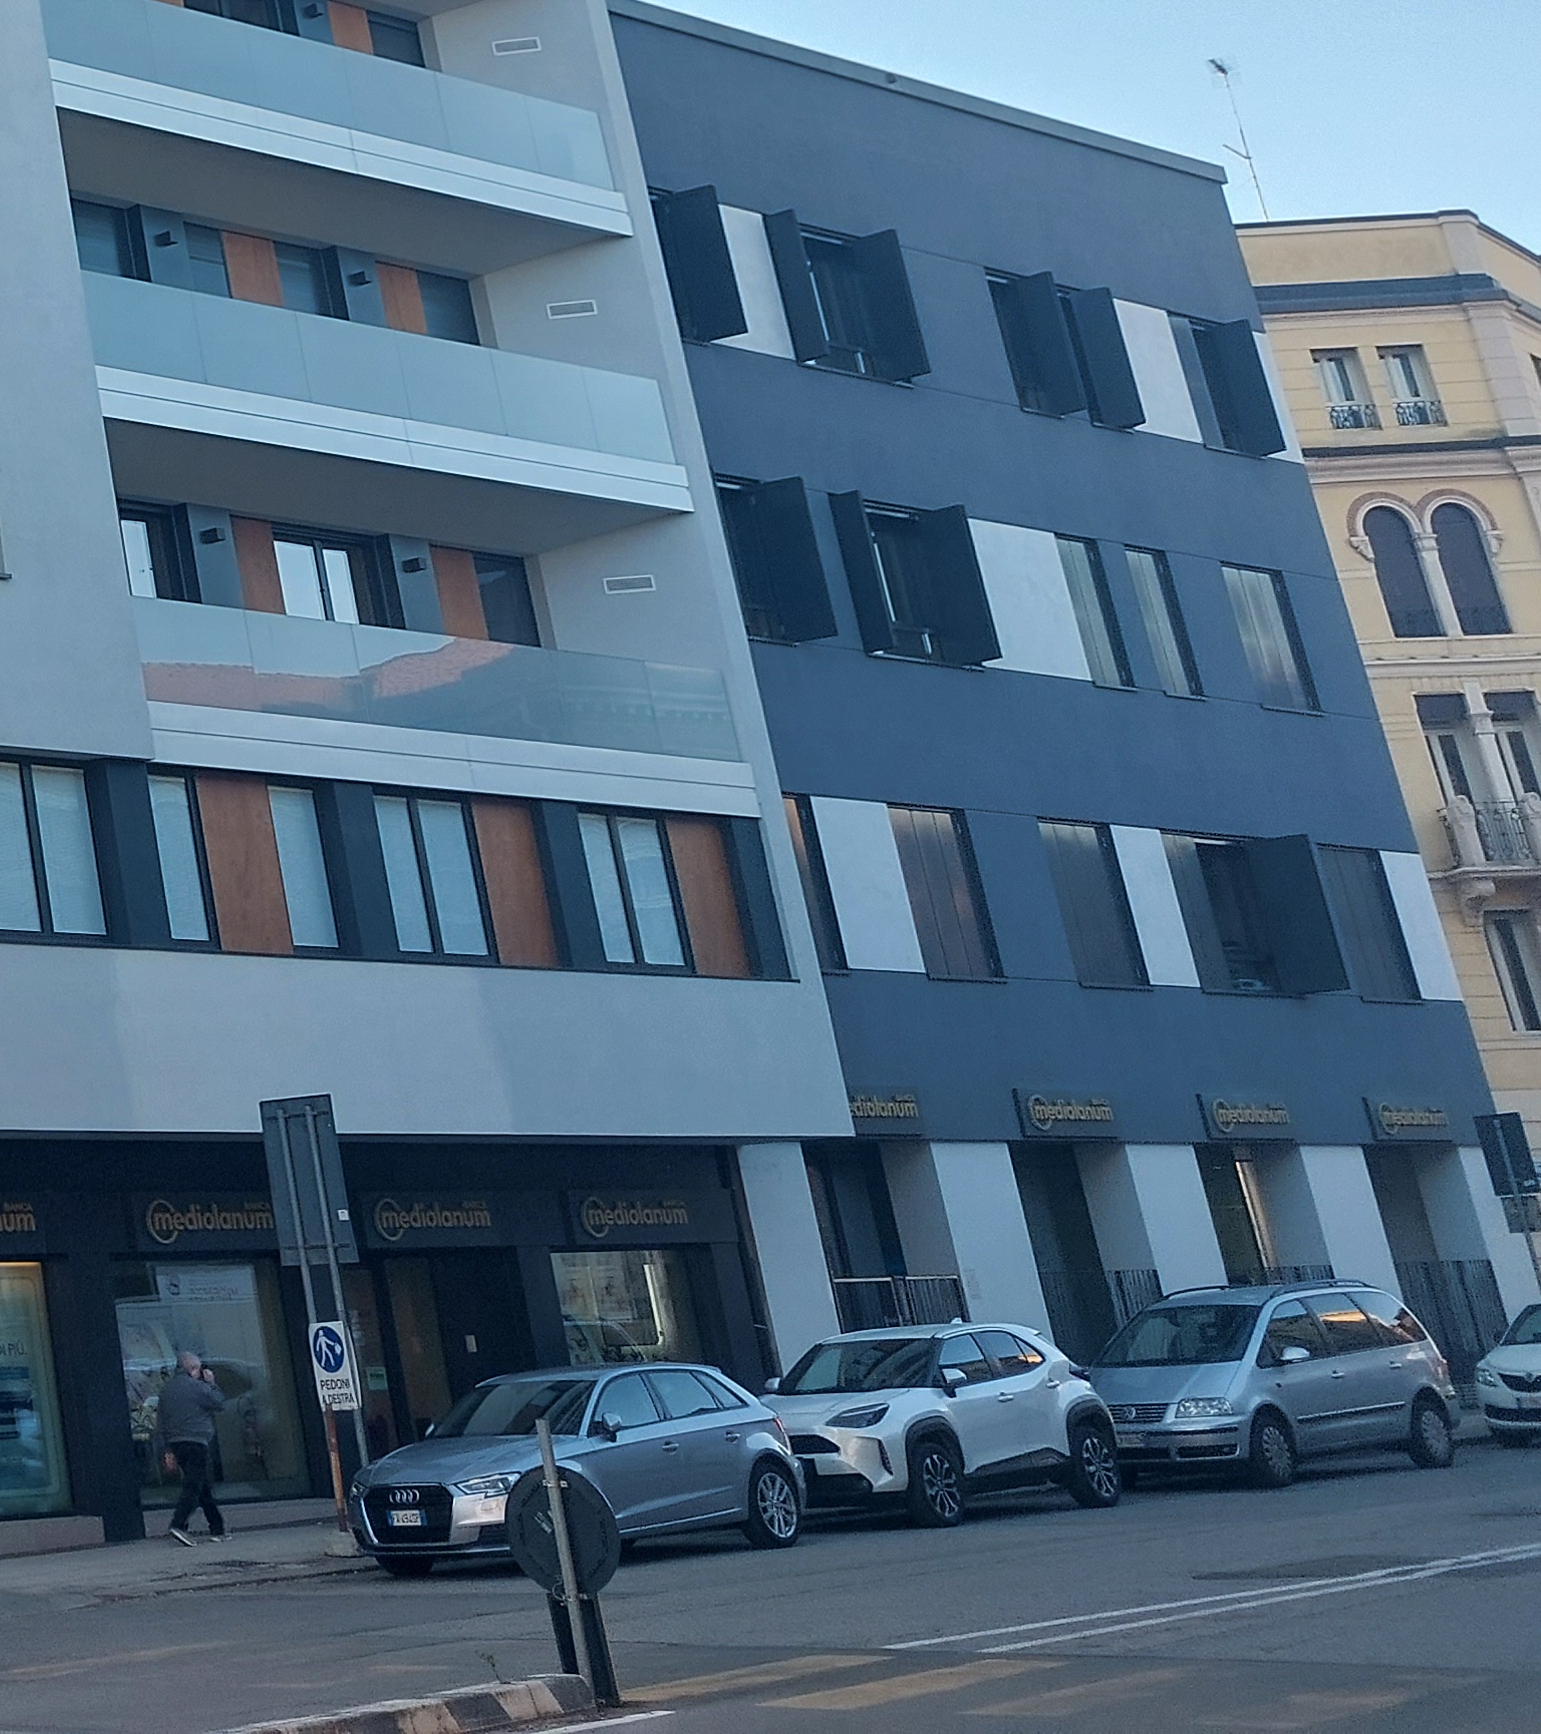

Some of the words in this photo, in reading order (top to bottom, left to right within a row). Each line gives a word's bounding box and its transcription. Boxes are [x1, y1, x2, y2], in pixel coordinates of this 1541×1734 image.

[1034, 1099, 1114, 1120] mediolanum
[153, 1203, 274, 1230] mediolanum
[381, 1202, 491, 1228] mediolanum
[588, 1201, 688, 1226] mediolanum
[320, 1378, 351, 1391] PEDONI
[328, 1392, 355, 1406] DESTRA
